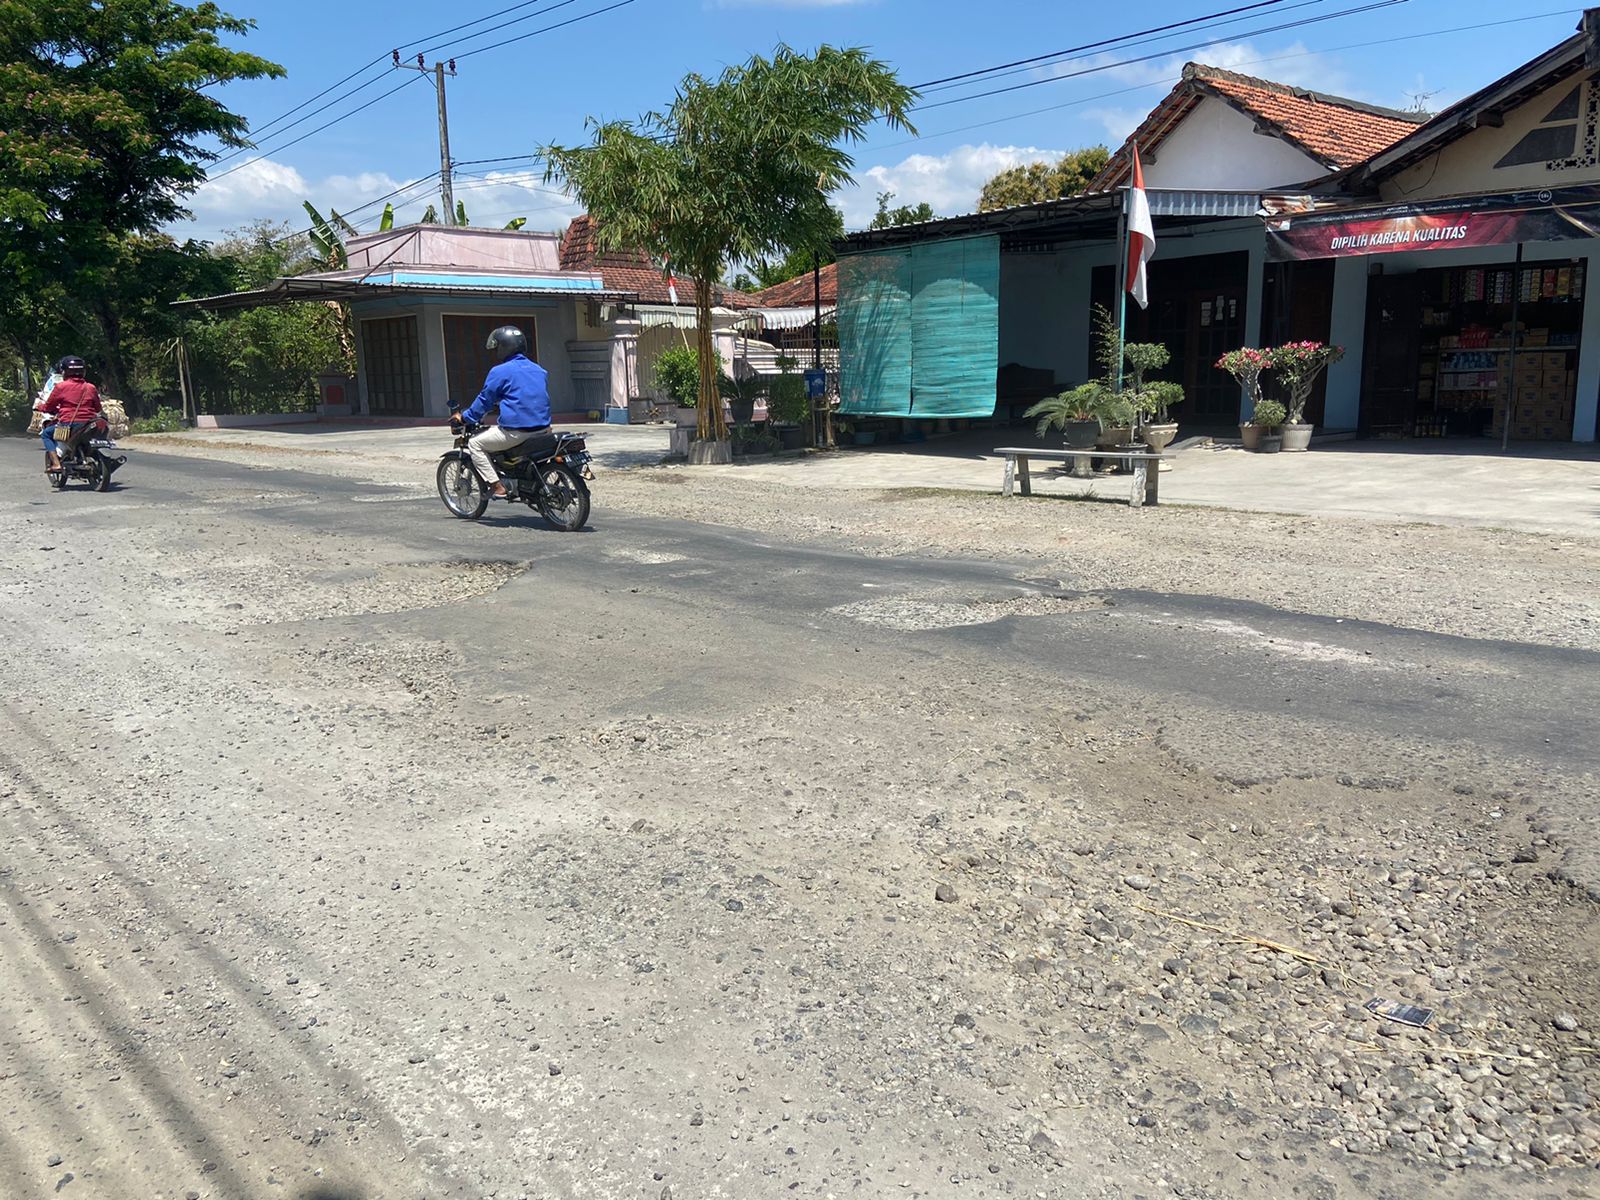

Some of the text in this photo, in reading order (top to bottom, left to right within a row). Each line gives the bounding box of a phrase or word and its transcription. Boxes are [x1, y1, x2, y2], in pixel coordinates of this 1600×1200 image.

[1331, 225, 1467, 249] DIPILIH KARENA KUALITAS
